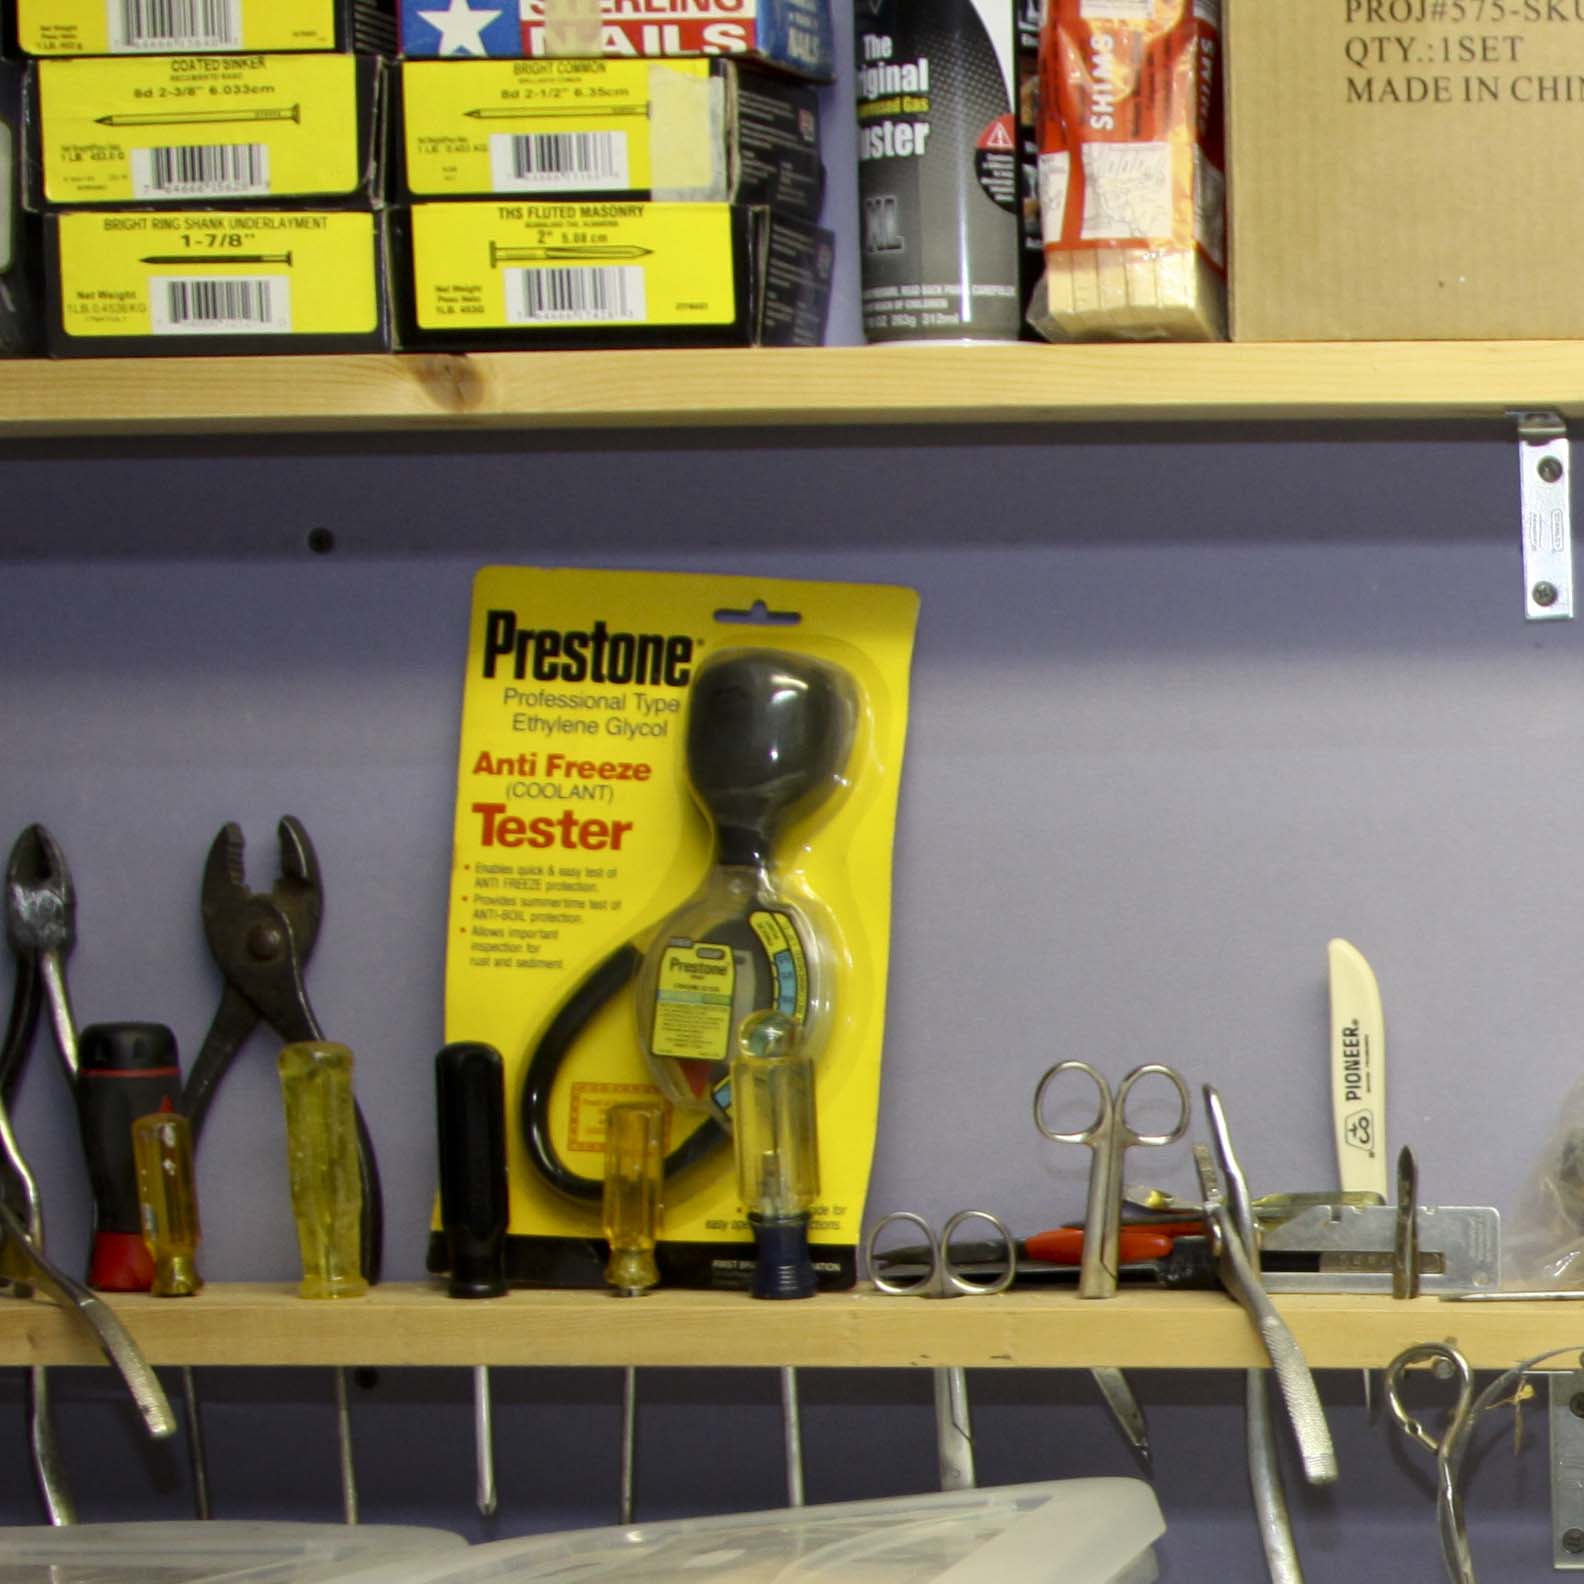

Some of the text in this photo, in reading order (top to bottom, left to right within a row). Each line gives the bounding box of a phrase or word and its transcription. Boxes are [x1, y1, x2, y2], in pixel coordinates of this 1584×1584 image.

[531, 22, 746, 56] NAILS
[863, 33, 892, 60] The
[221, 56, 266, 71] SINKER
[513, 61, 607, 75] BRIGHT COMMON
[1090, 32, 1114, 131] SHIMS
[1344, 77, 1452, 102] MADE
[1463, 77, 1500, 102] IN
[104, 216, 328, 231] BRIGHT RING SHANK UNDERLAYMENT
[498, 206, 644, 219] THS FLUTED MASONRY
[181, 234, 256, 248] 1-7/8"
[483, 608, 693, 686] Prestone
[503, 687, 681, 716] Professional Type
[512, 713, 668, 740] Ethylene Glycol
[472, 751, 652, 782] Anti Freeze
[506, 781, 614, 803] (COOLANT)
[472, 802, 633, 851] Tester
[1341, 1023, 1361, 1102] PIONEER
